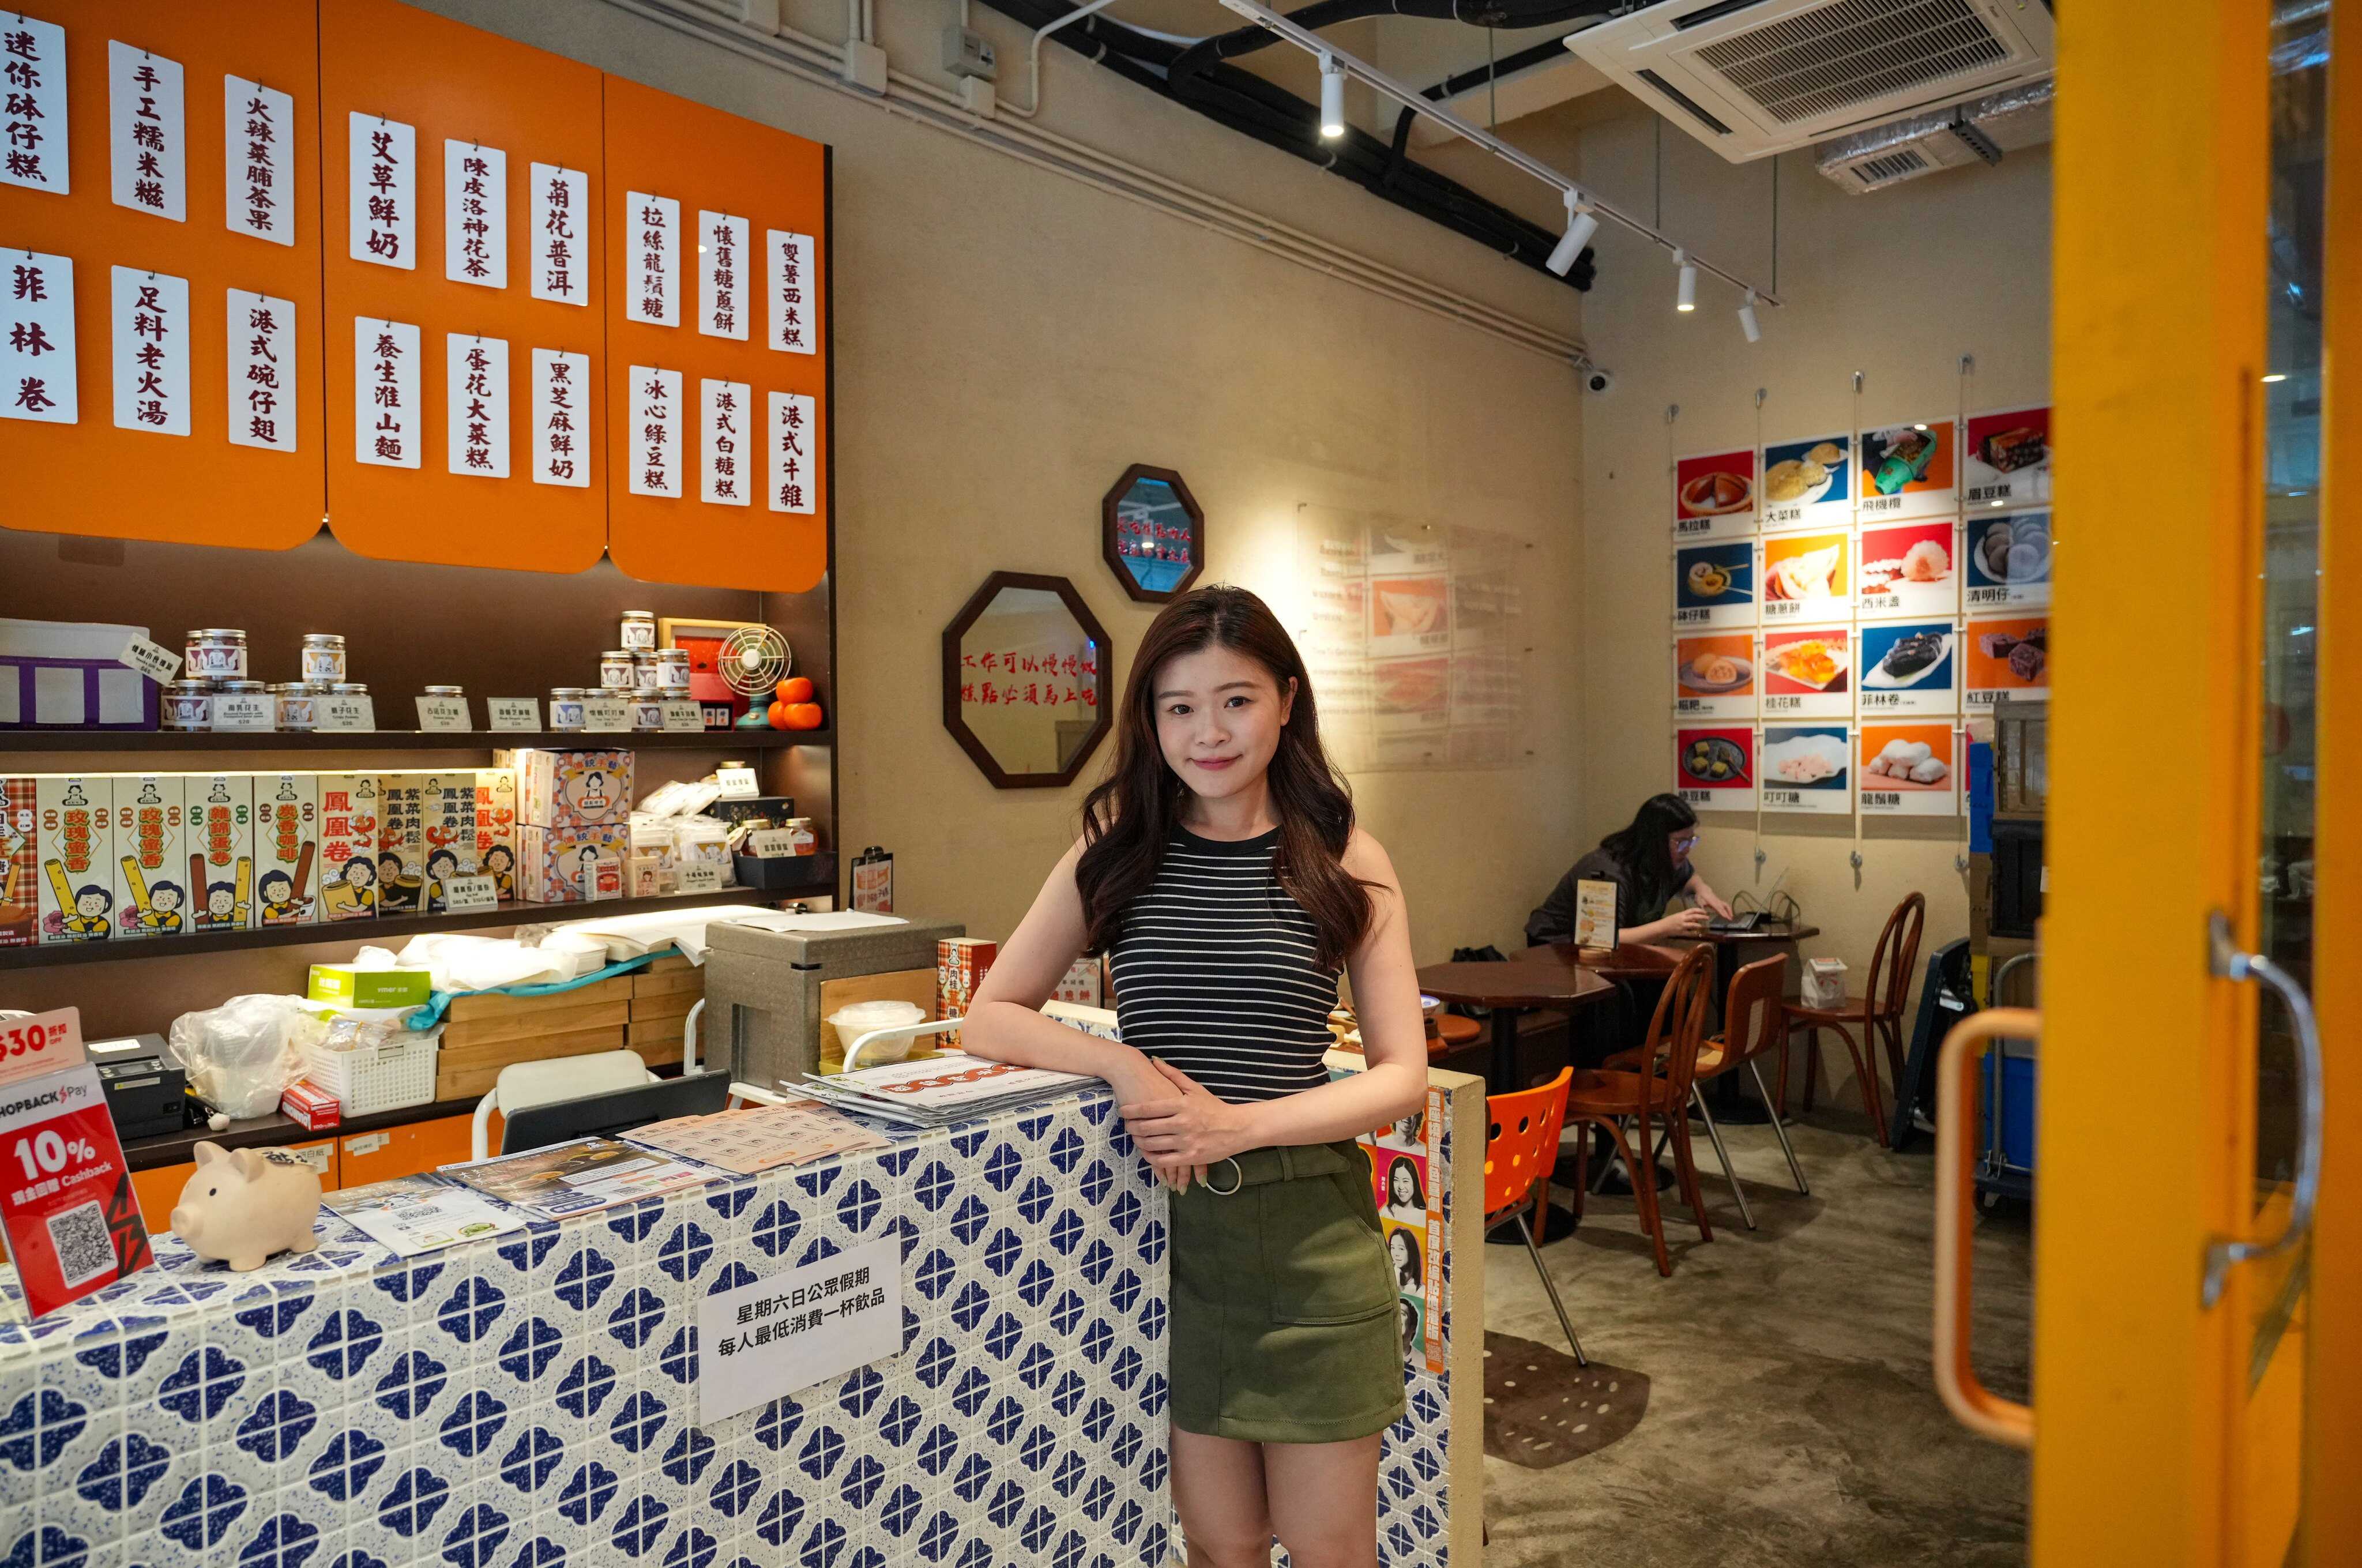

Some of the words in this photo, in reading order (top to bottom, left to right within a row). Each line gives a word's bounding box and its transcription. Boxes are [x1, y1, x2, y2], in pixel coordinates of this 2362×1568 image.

[3, 31, 47, 183] 迷你砵仔糕
[133, 66, 166, 210] 手工糯米糍
[245, 97, 276, 231] 火辣菜脯茶果
[366, 131, 400, 260] 艾草鮮奶
[462, 157, 491, 278] 陳皮洛神花茶
[546, 179, 574, 296] 菊花普洱
[641, 206, 666, 319] 拉絲龍鬚糖
[10, 265, 56, 413] 菲林卷
[781, 243, 804, 347] 雙薯西米糕
[134, 286, 169, 426] 足料老火湯
[246, 308, 280, 443] 港式碗仔翅
[373, 334, 404, 461] 養生淮山麵
[465, 349, 494, 470] 蛋花大菜糕
[548, 362, 575, 480] 黑芝麻鮮奶
[644, 380, 668, 491] 冰心綠豆糕
[715, 393, 738, 499] 港式白糖糕
[780, 405, 804, 508] 港式牛雜
[1679, 519, 1710, 532] 馬拉糕
[1766, 509, 1800, 522] 大菜糕
[1967, 588, 2009, 603] 清明仔
[1766, 697, 1800, 709] 桂花糕
[1862, 694, 1899, 706] 菲林卷
[323, 791, 352, 862] 鳳凰卷
[387, 788, 404, 829] 鳳凰卷
[405, 788, 420, 844] 紫菜肉鬆
[442, 788, 459, 828] 鳳凰卷
[460, 787, 476, 841] 紫菜肉鬆
[1763, 791, 1799, 803] 叮叮糖
[67, 1085, 87, 1097] Pay
[14, 1130, 96, 1181] 10%
[62, 1161, 113, 1187] Cashback
[719, 1287, 885, 1357] 每人最低消費一杯飲品
[737, 1266, 870, 1325] 星期六日公眾假期
